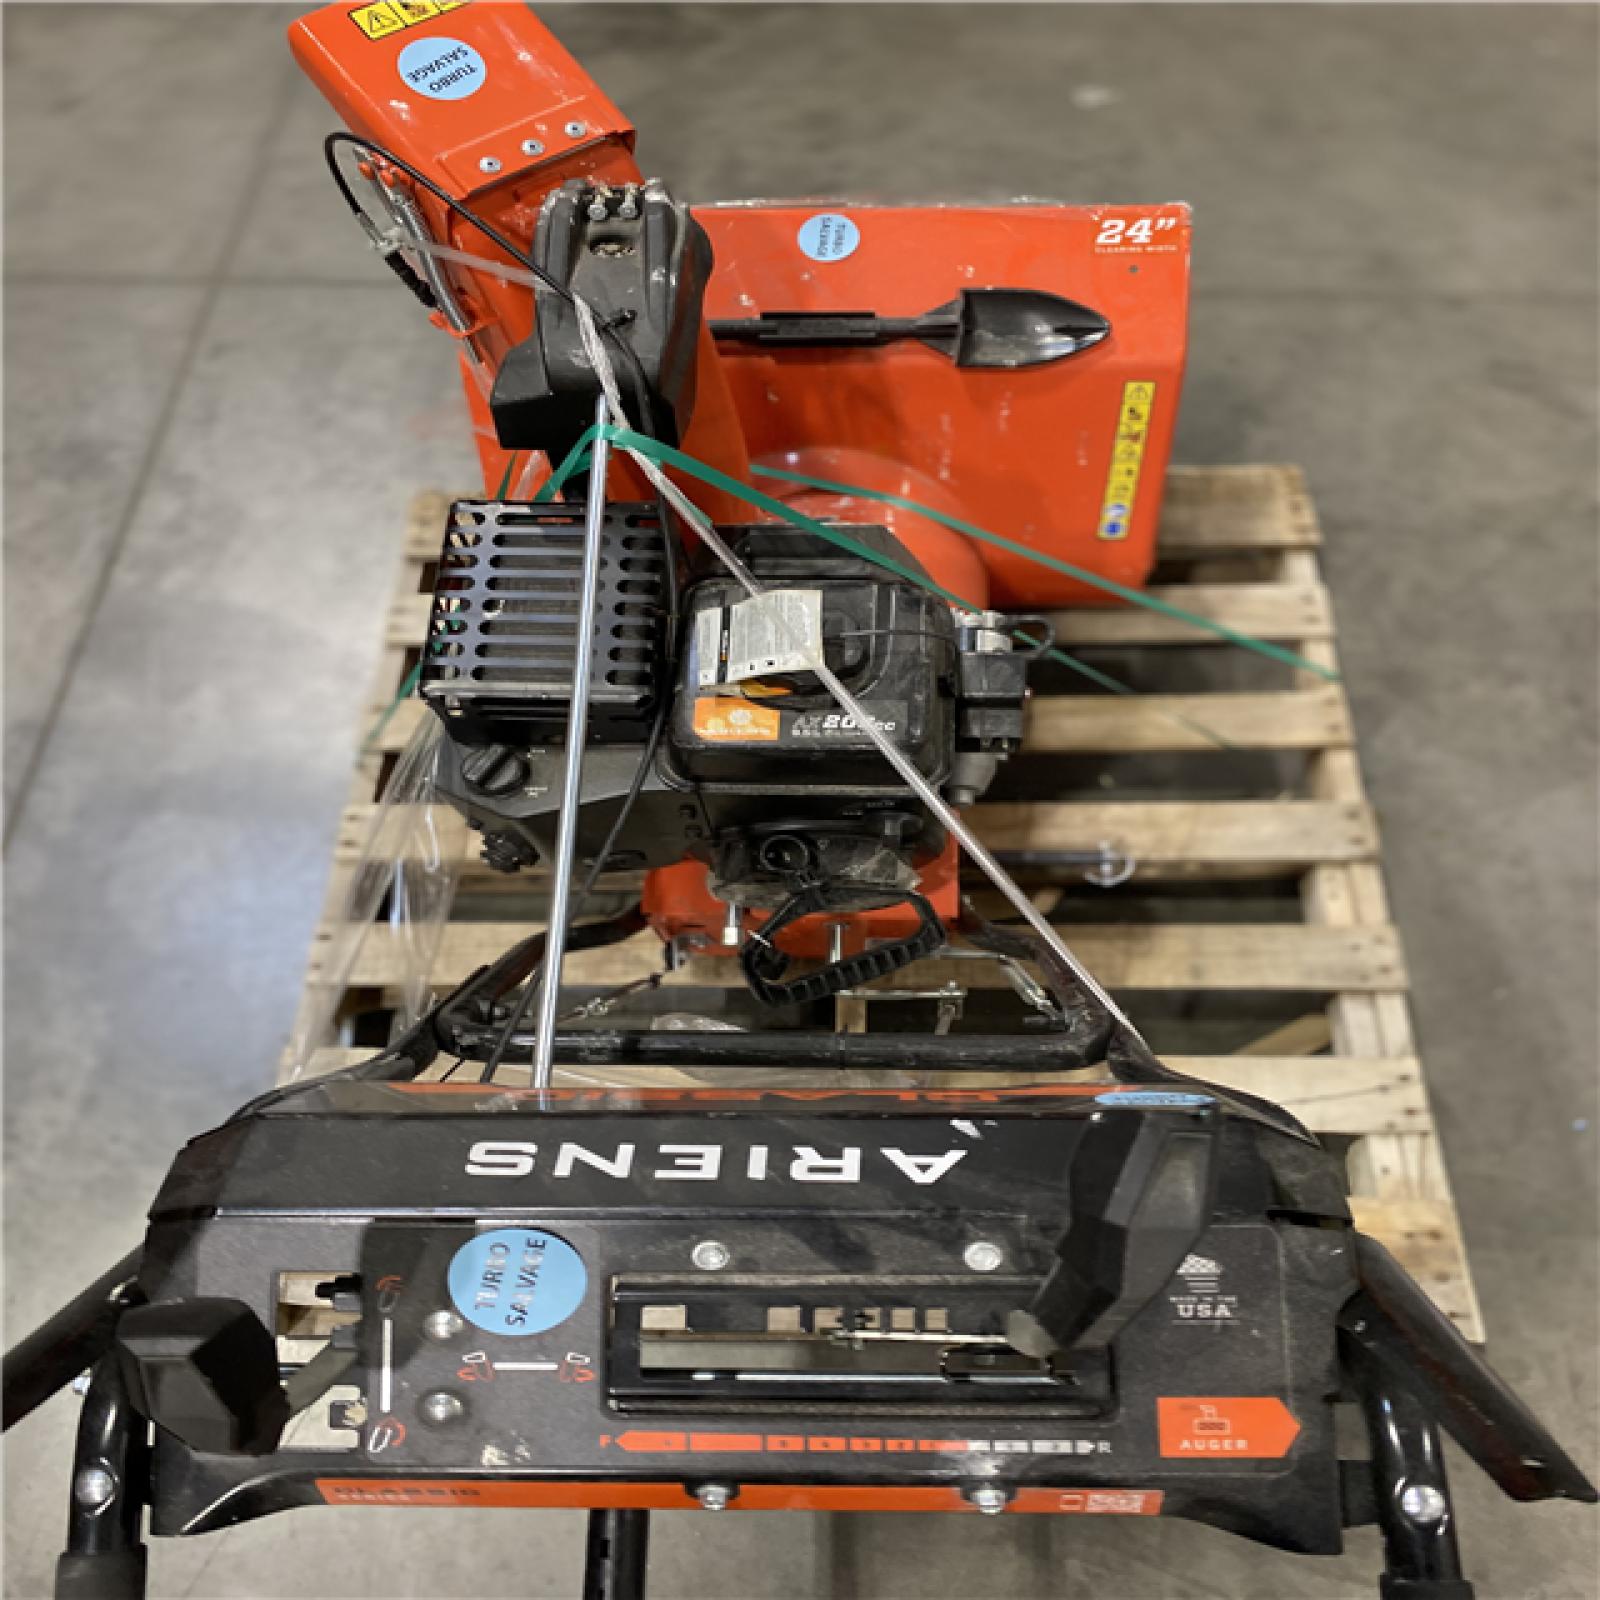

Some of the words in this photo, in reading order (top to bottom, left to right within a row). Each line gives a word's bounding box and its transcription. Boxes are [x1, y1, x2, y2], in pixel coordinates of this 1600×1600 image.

[464, 1141, 969, 1185] ARIENS
[474, 1242, 511, 1311] TURBO
[504, 1237, 548, 1327] SALVAGE
[1177, 1304, 1232, 1318] USA
[1180, 1439, 1248, 1450] AUGER
